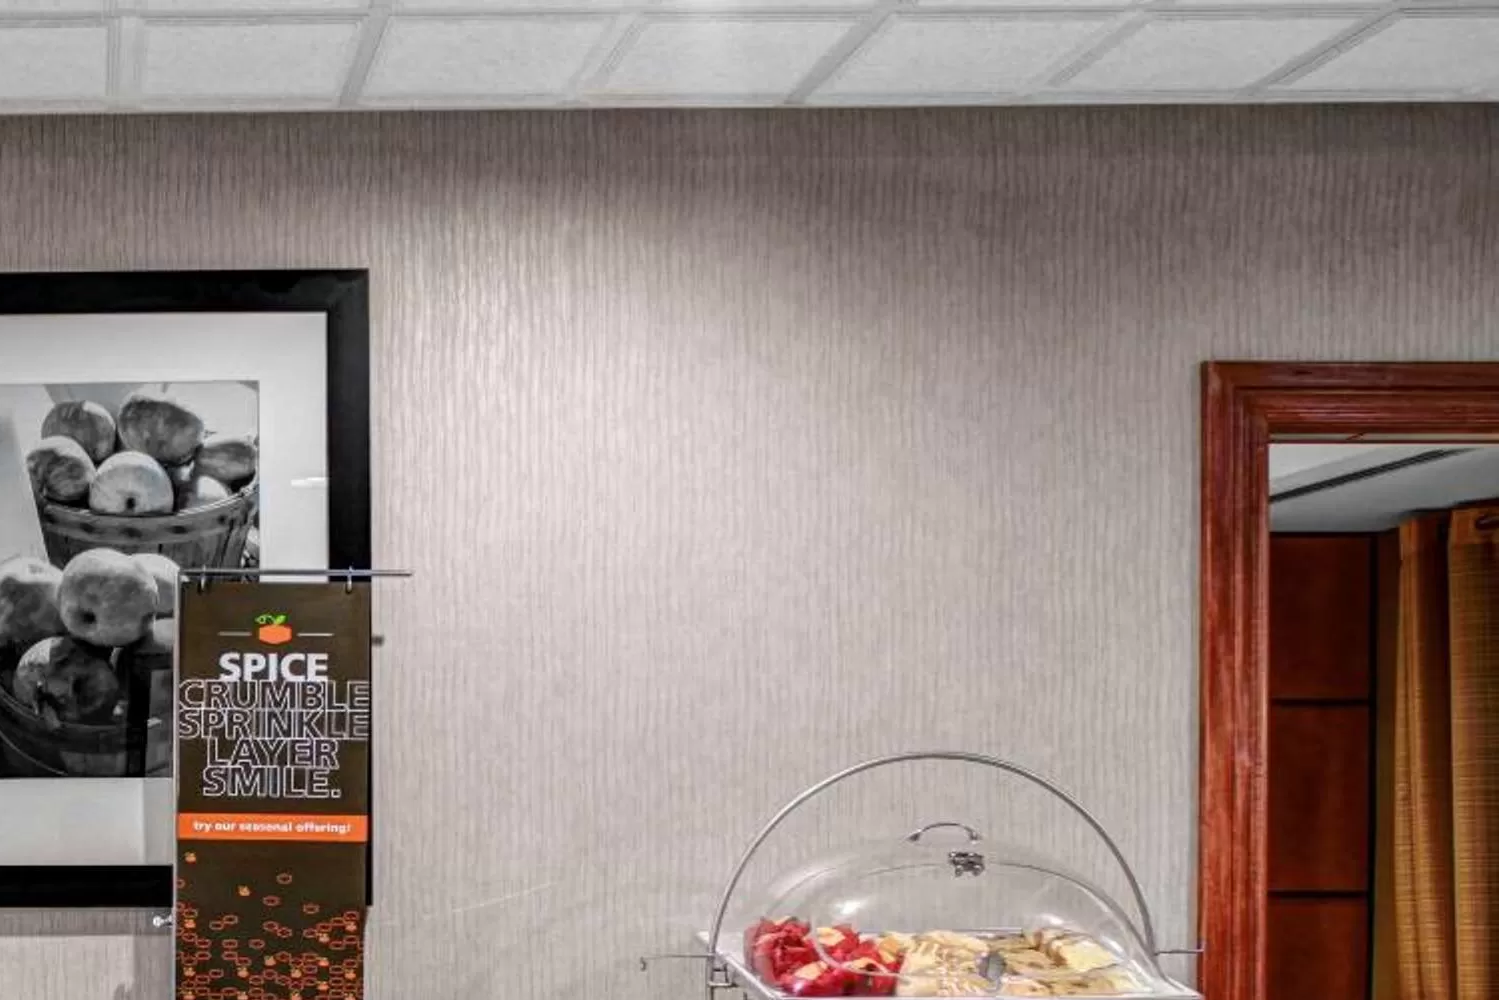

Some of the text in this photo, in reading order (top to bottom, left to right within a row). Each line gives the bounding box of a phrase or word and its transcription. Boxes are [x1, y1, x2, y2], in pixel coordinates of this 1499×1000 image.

[219, 653, 329, 682] SPICE
[178, 680, 369, 711] CRUMBLE
[178, 709, 369, 740] SPRINKLE
[206, 738, 340, 770] LAYER
[202, 766, 341, 798] SMILE.
[193, 820, 351, 835] try our seasonal offering!
